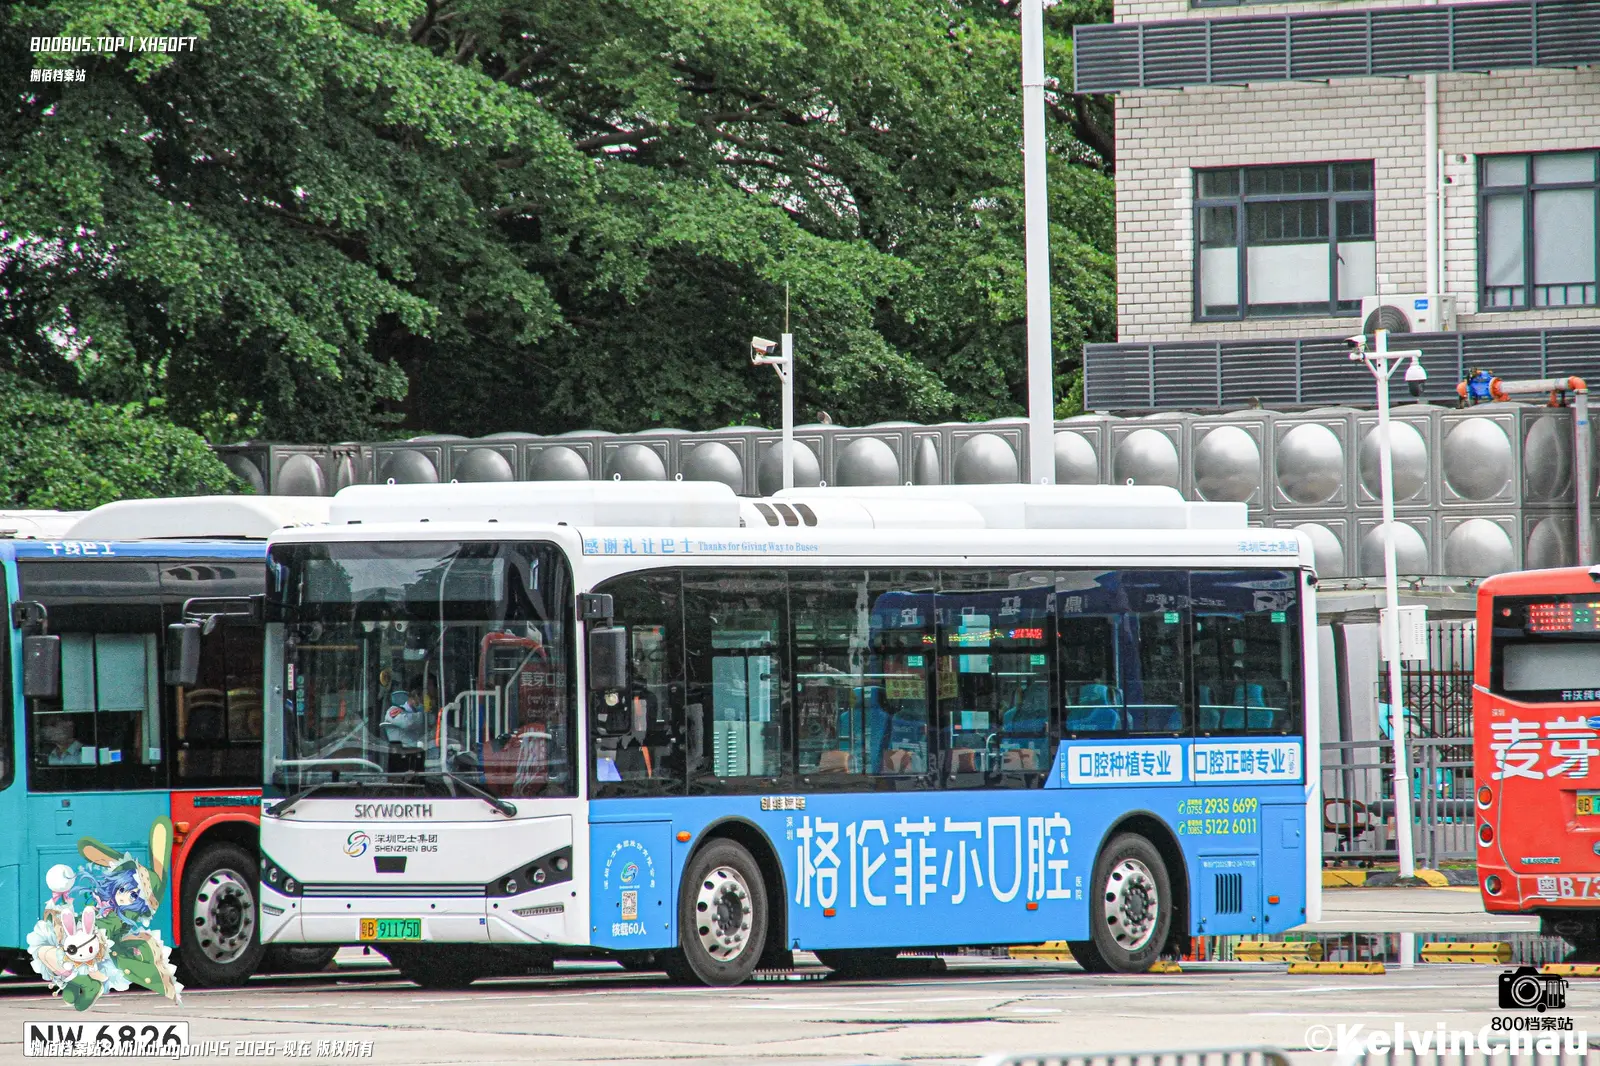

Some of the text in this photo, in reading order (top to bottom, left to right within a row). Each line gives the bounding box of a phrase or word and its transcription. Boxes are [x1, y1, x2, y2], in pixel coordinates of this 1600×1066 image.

[584, 538, 819, 554] 感谢礼让巴士 Thanks for Giving Way to Buses
[1237, 541, 1298, 553] 深圳巴士集团
[1490, 716, 1600, 781] 麦芽
[1079, 750, 1171, 777] 口腔种植专业
[1194, 748, 1285, 775] 口腔正畸专业
[354, 804, 433, 818] SKYWORTH
[1205, 798, 1229, 814] 2935
[1232, 797, 1257, 814] 6699
[1205, 818, 1229, 834] 5122
[1232, 818, 1256, 834] 6011
[374, 834, 438, 844] 深圳巴士集团
[374, 845, 438, 853] SHENZHEN BUS
[795, 812, 1071, 908] 格伦菲尔口腔
[1537, 876, 1574, 902] 粤B
[379, 921, 421, 938] 91175D
